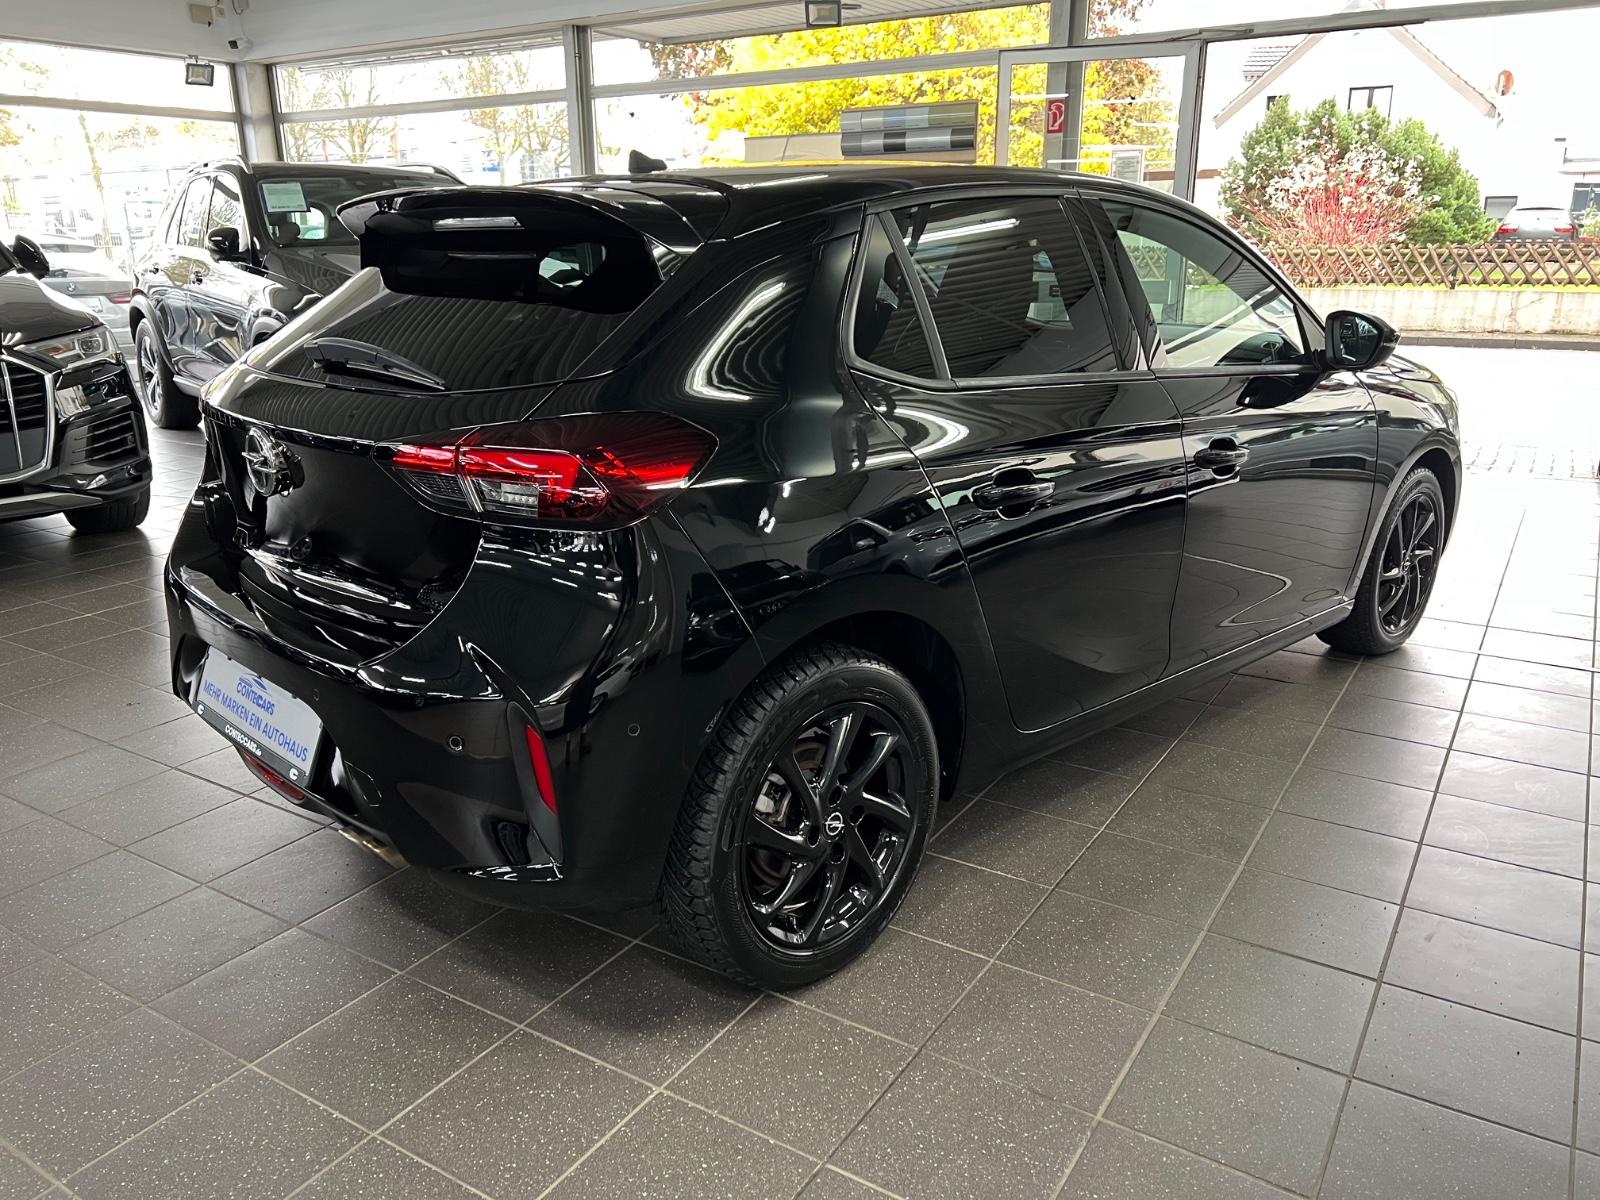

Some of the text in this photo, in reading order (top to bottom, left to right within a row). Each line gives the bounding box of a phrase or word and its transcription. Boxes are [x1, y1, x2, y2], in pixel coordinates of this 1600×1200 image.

[203, 680, 309, 762] MEHR MARKEN EIN AUTOHAUS
